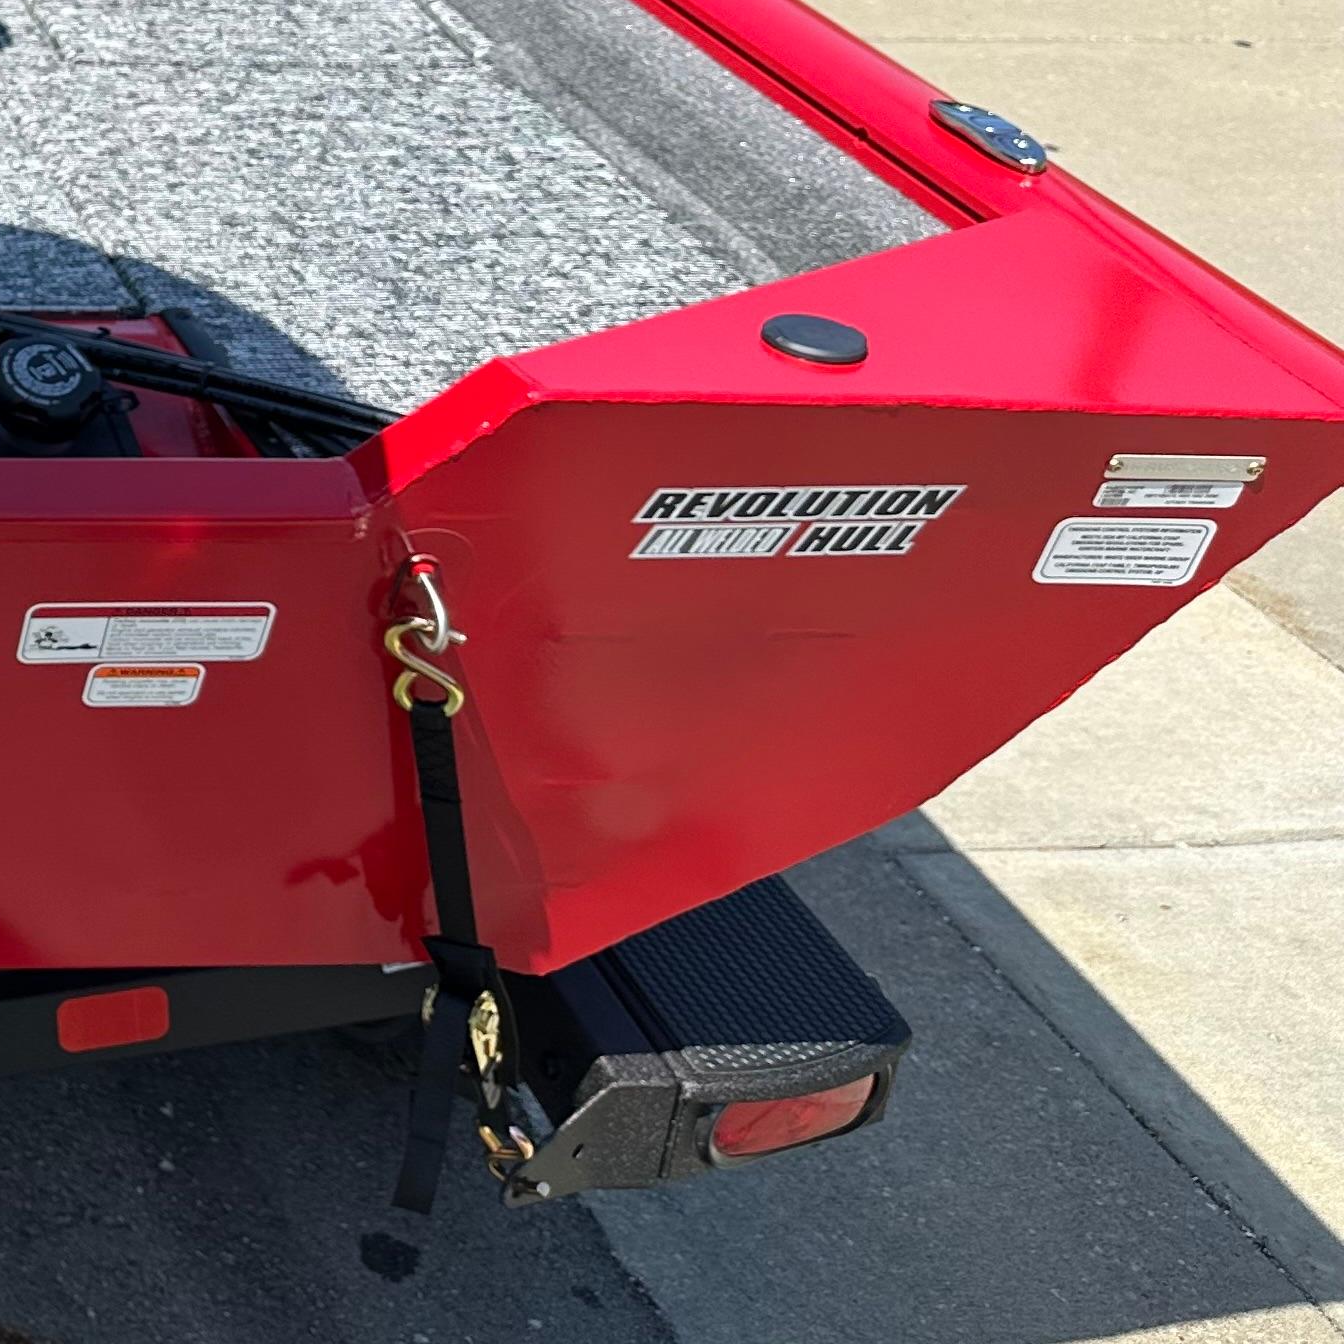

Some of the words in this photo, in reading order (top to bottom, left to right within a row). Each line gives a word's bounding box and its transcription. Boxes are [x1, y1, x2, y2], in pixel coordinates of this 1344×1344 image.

[639, 489, 959, 519] REVOLUTION
[643, 528, 694, 554] ALL
[687, 528, 784, 553] WELDED
[791, 525, 919, 553] HULL
